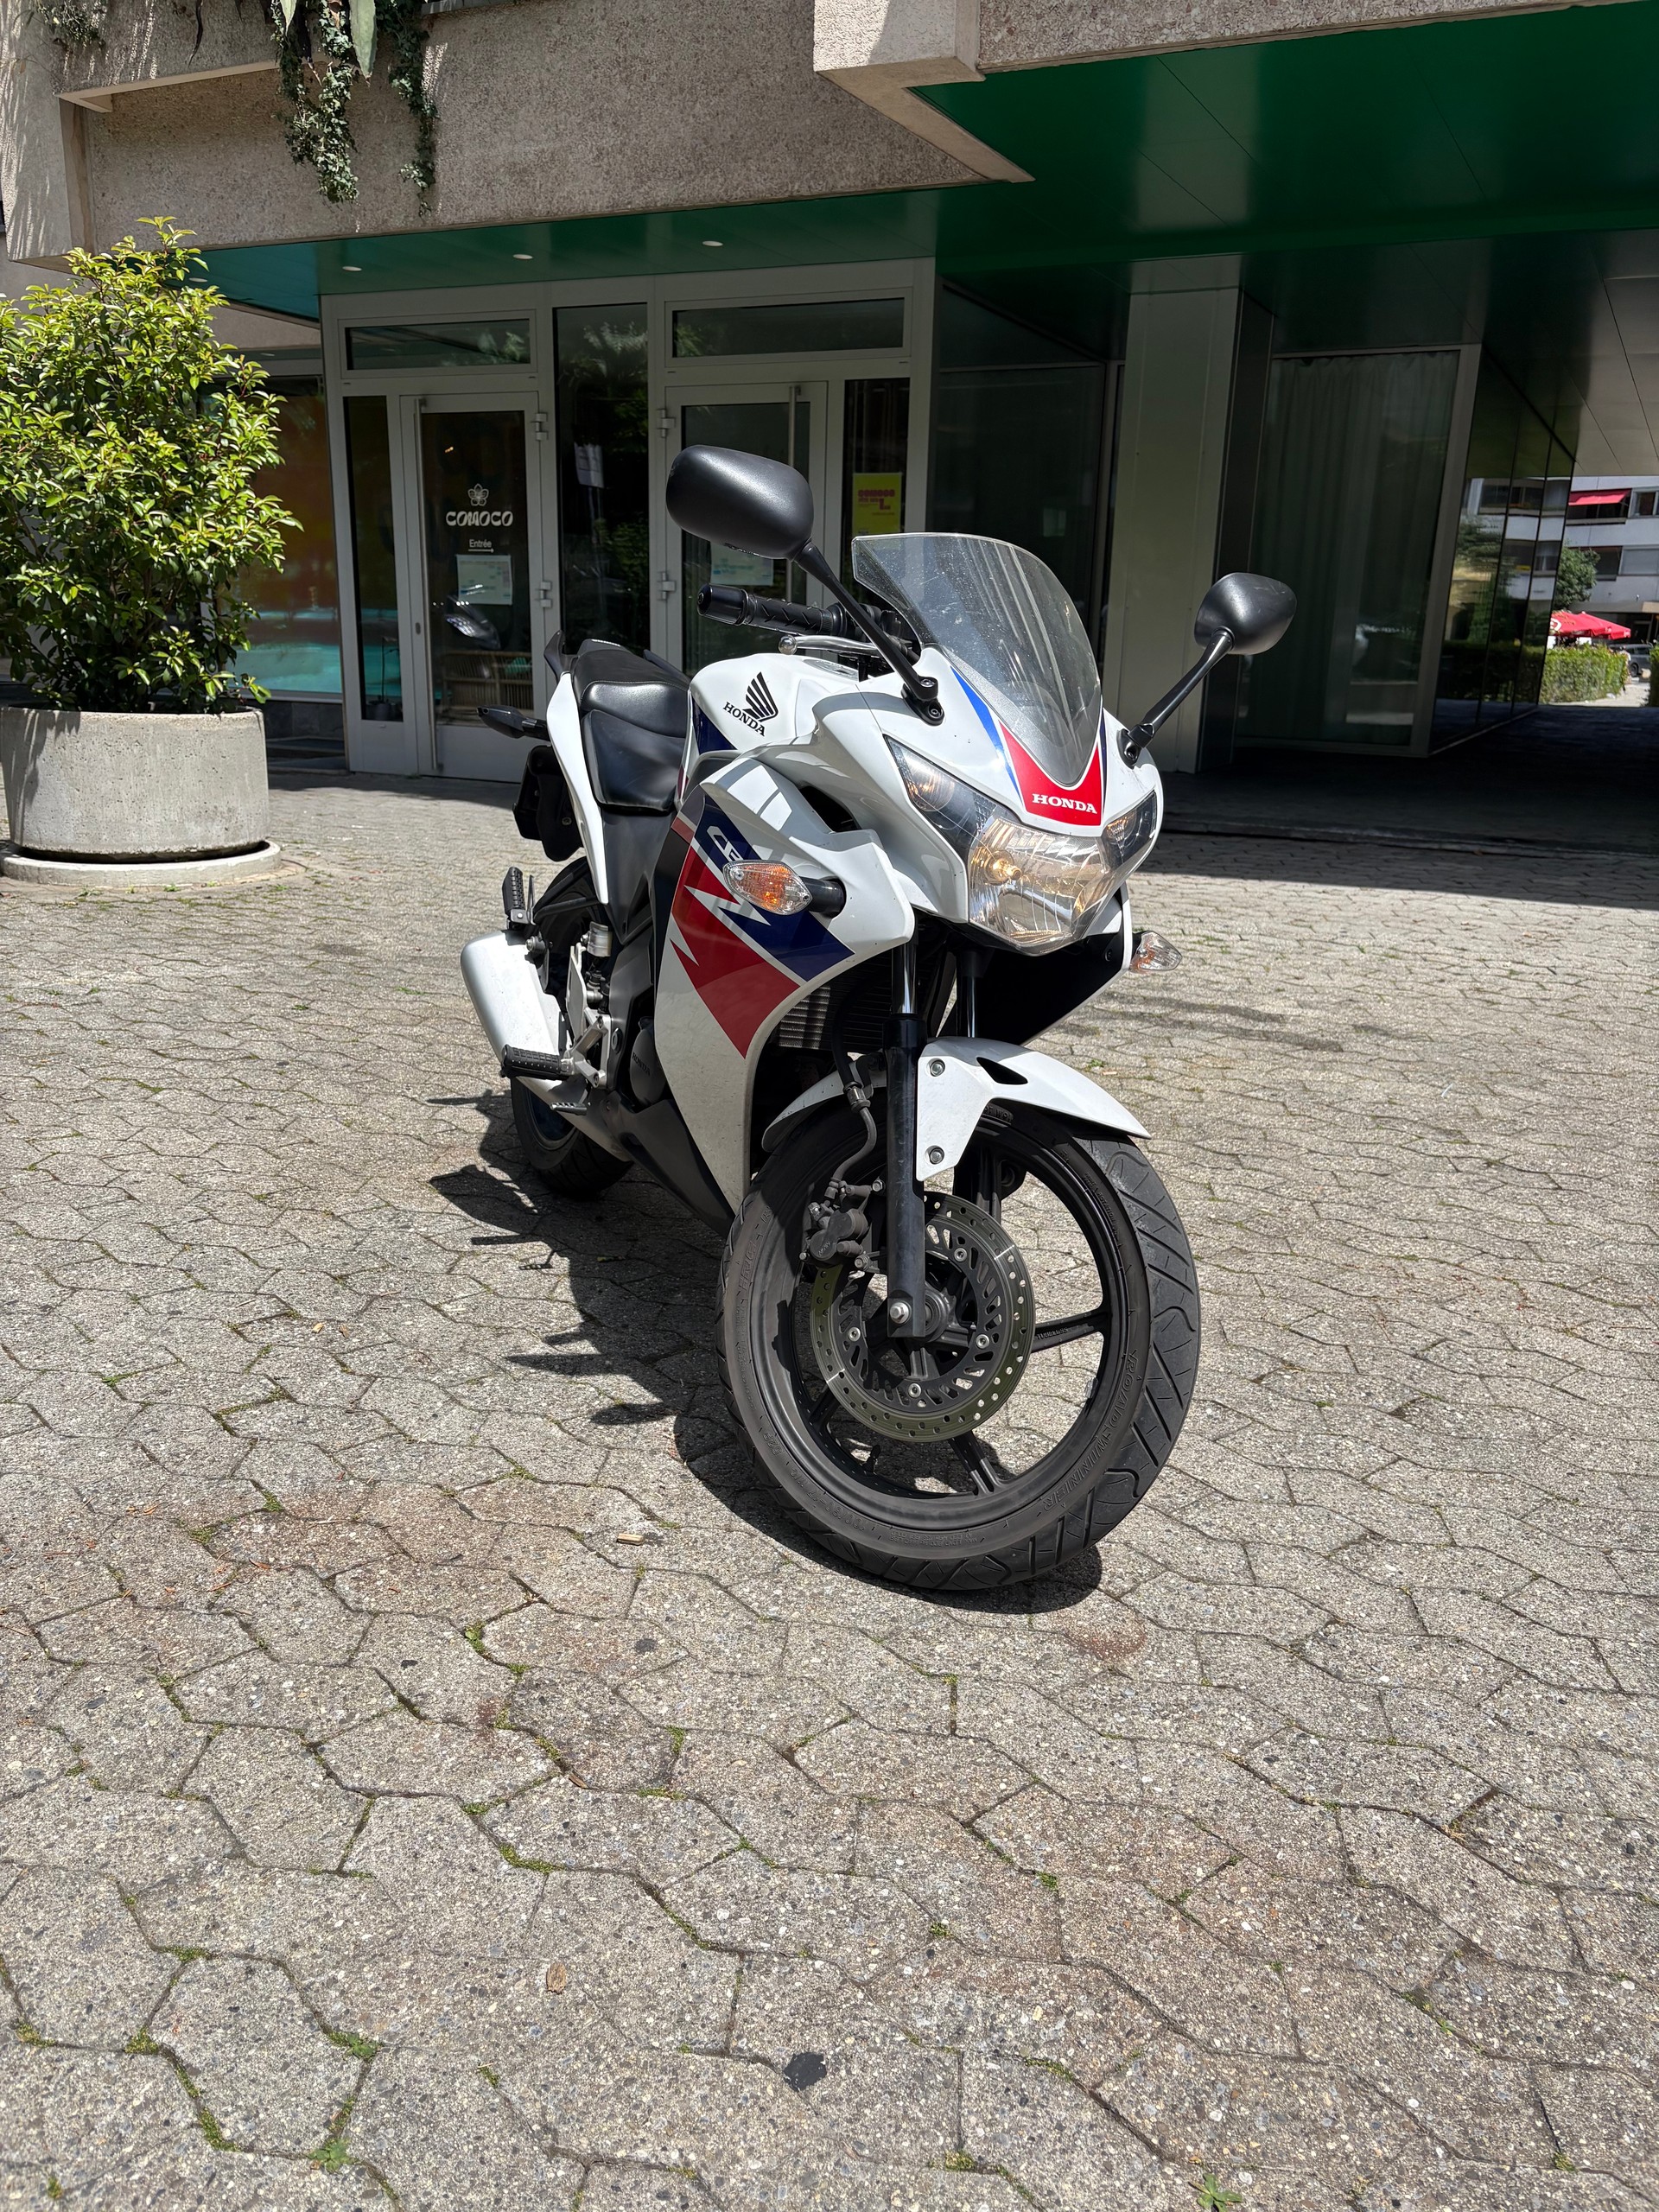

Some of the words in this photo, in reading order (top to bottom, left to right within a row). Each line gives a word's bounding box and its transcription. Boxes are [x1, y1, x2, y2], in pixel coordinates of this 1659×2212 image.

[446, 511, 513, 527] COMOCO
[469, 539, 493, 548] Entrée
[723, 702, 765, 737] HONDA
[1032, 793, 1097, 814] HONDA
[632, 1052, 651, 1077] HONDA
